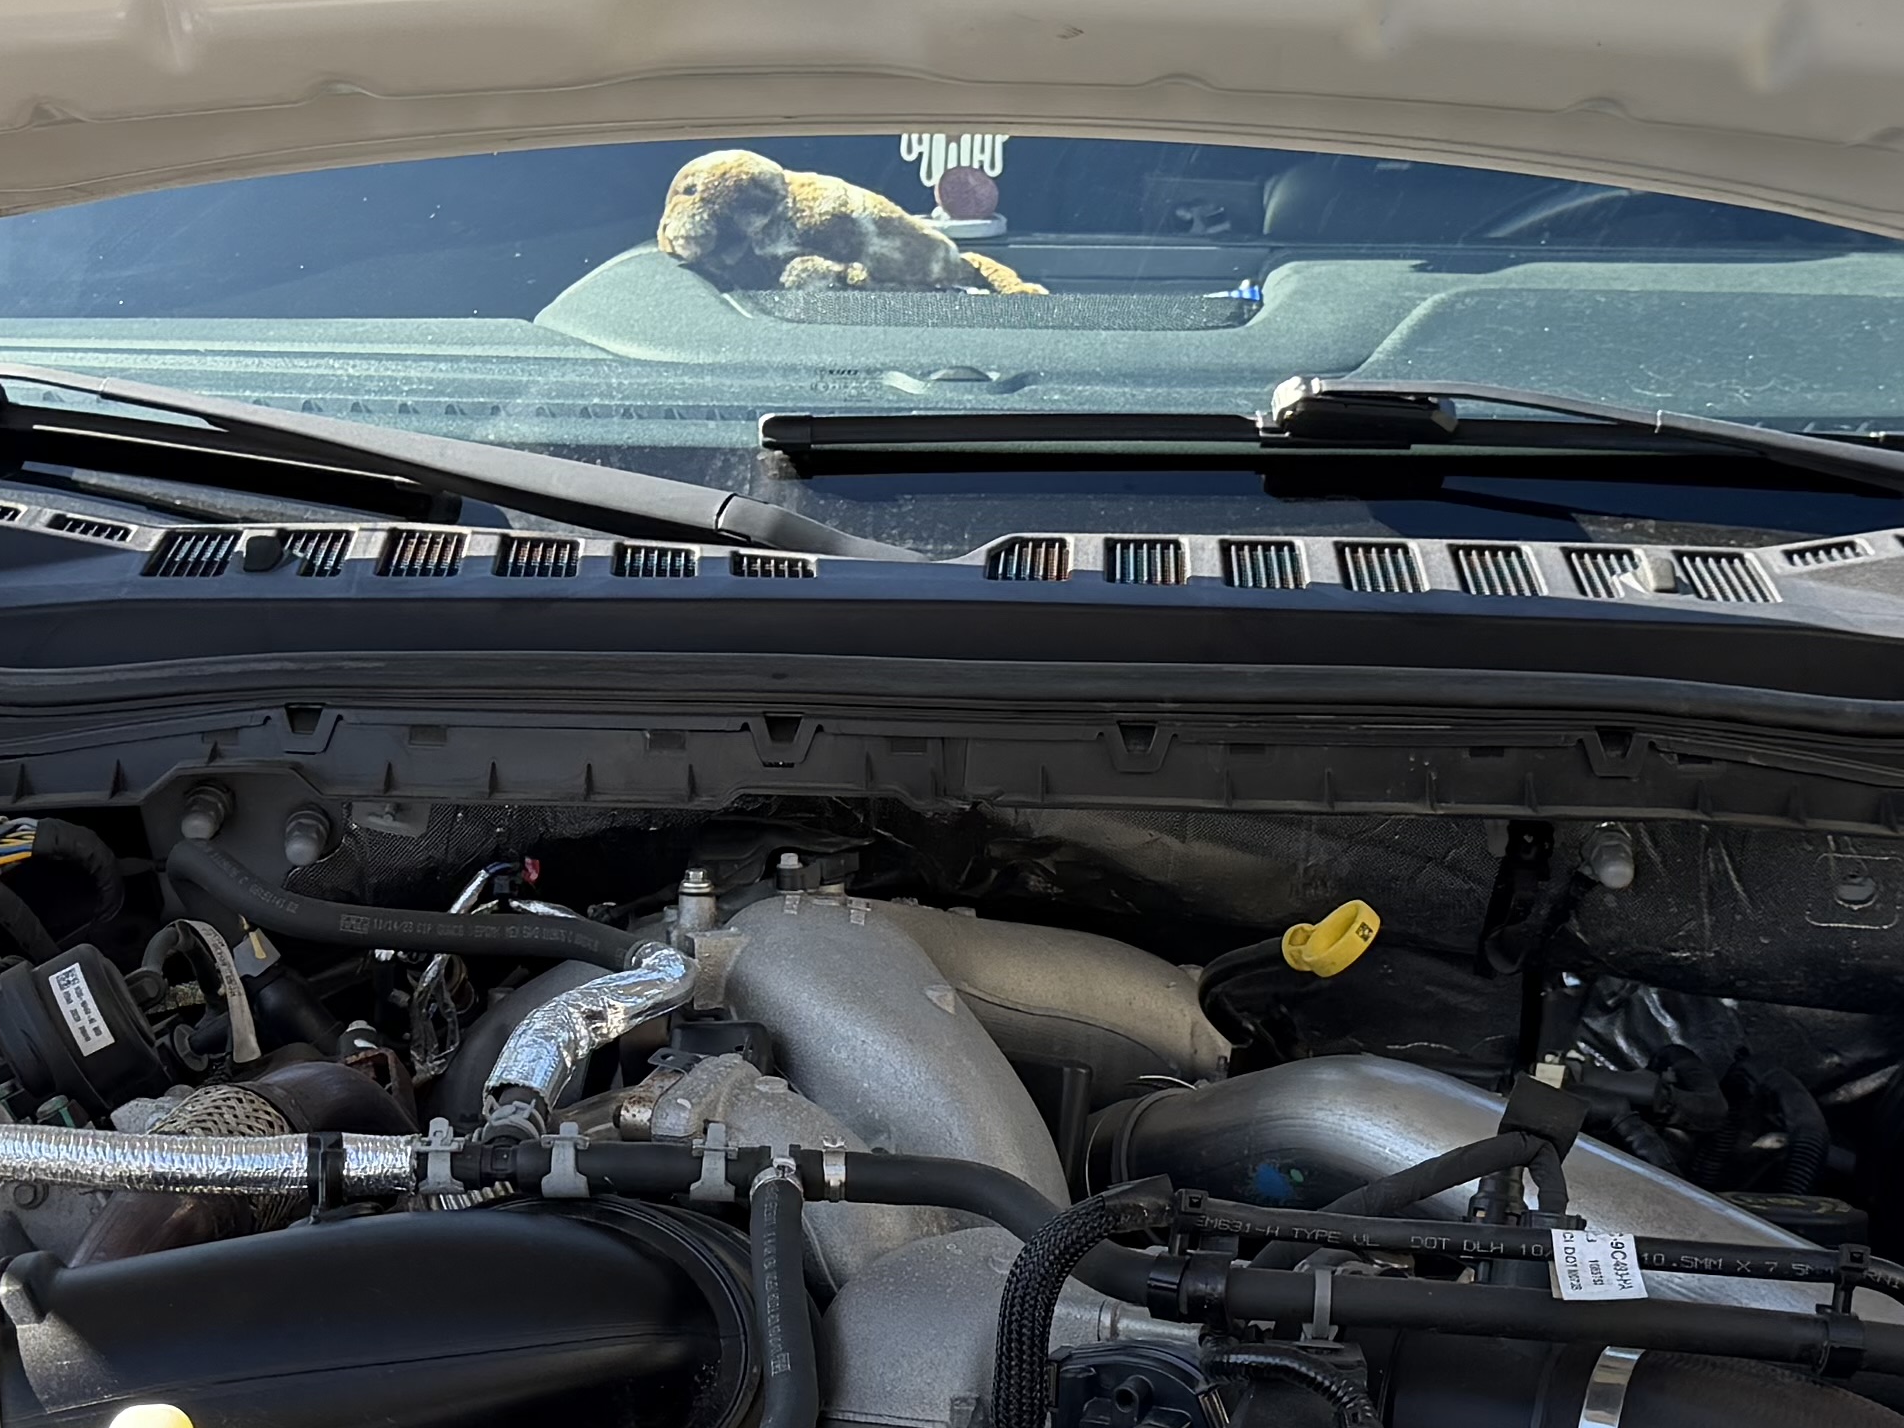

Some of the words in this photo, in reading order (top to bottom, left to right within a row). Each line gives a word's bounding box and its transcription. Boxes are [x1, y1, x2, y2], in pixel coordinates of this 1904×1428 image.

[1293, 1227, 1342, 1243] TYPE
[1411, 1235, 1451, 1250] DOT
[1463, 1240, 1504, 1254] DLH
[1736, 1259, 1751, 1272] X
